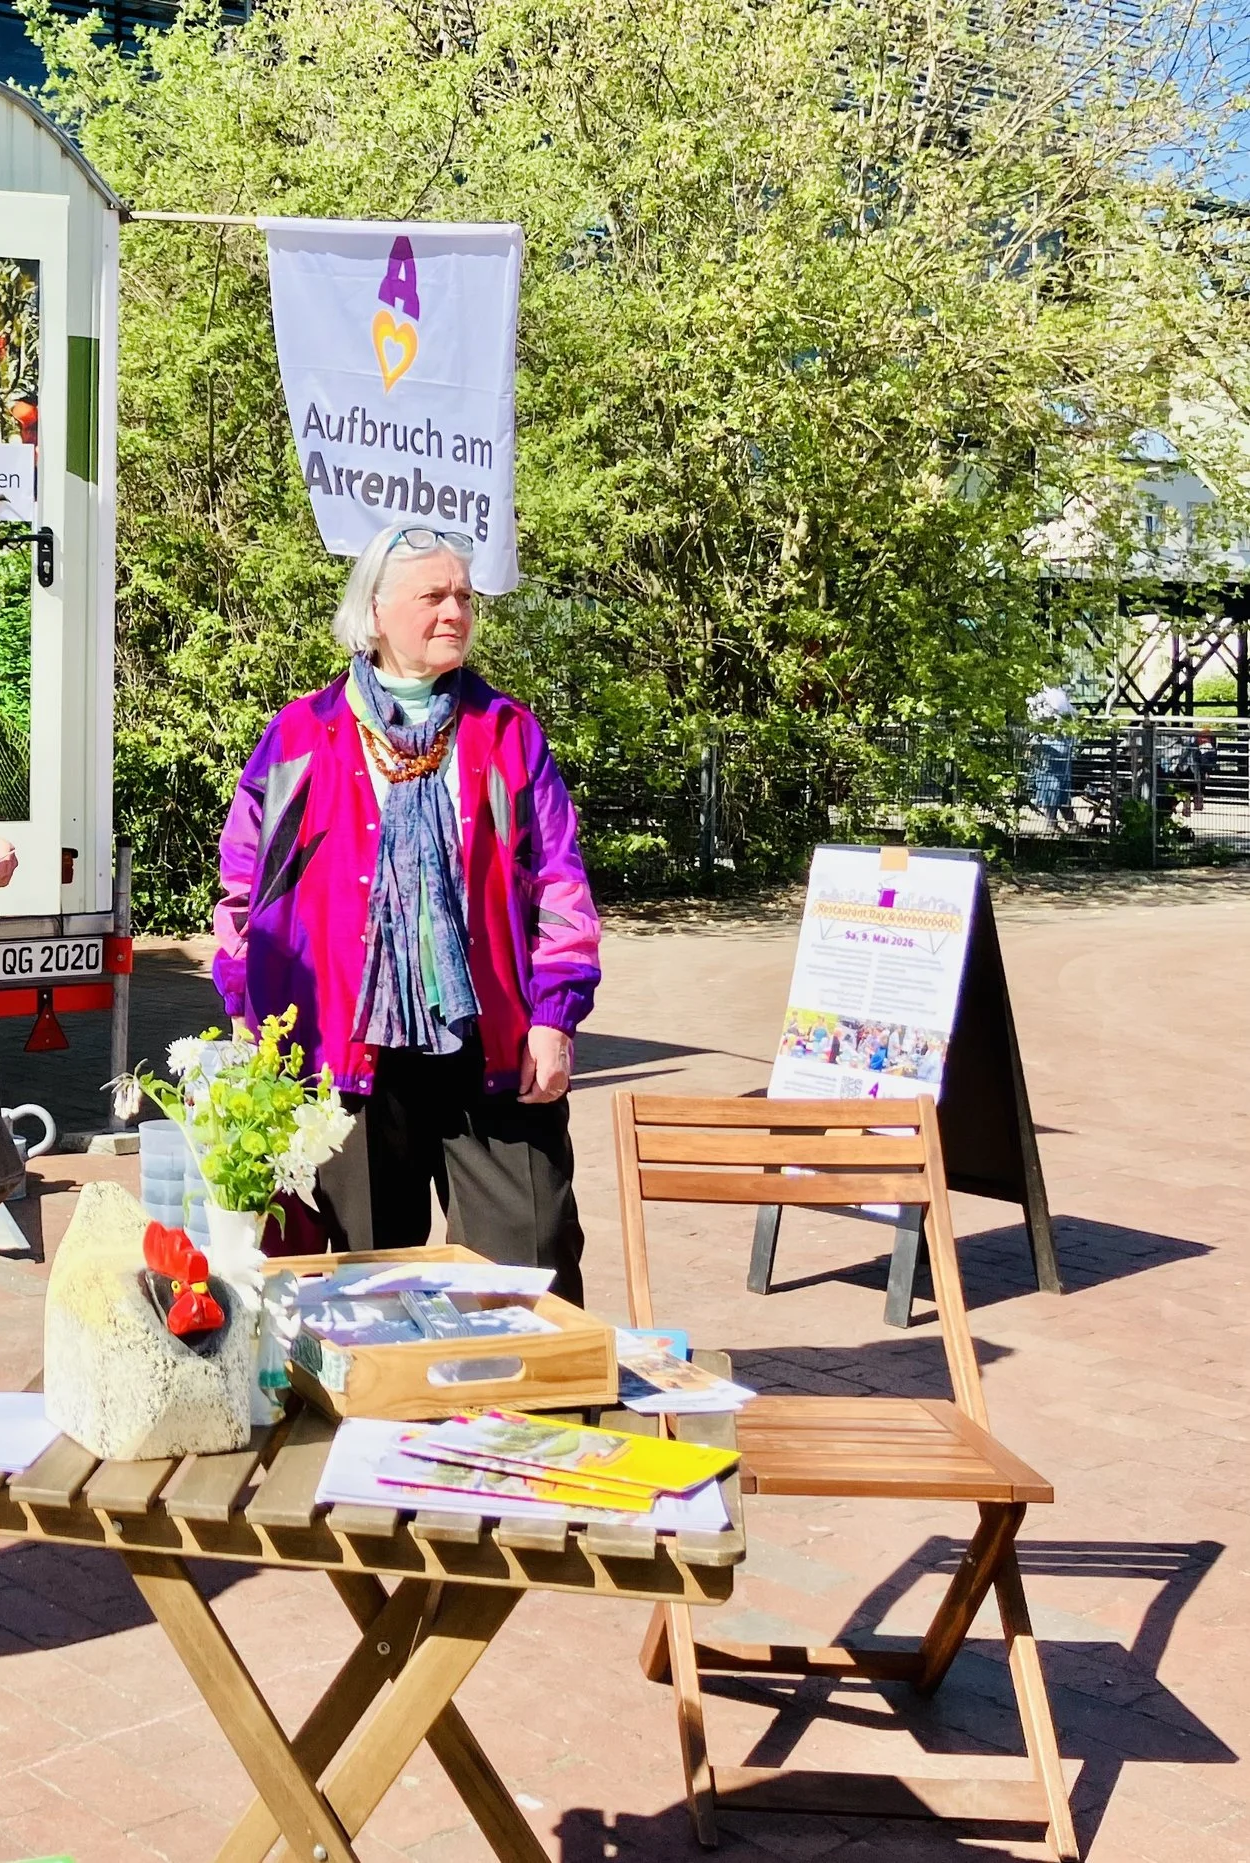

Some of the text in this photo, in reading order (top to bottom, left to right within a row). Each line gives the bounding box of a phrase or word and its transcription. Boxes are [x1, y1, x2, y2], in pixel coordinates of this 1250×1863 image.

[302, 402, 492, 469] Aufbruch am
[305, 451, 490, 542] Arrenberg
[2, 947, 33, 975] QG
[40, 943, 100, 973] 2020
[845, 930, 914, 948] Sa, 9. Mai 2026
